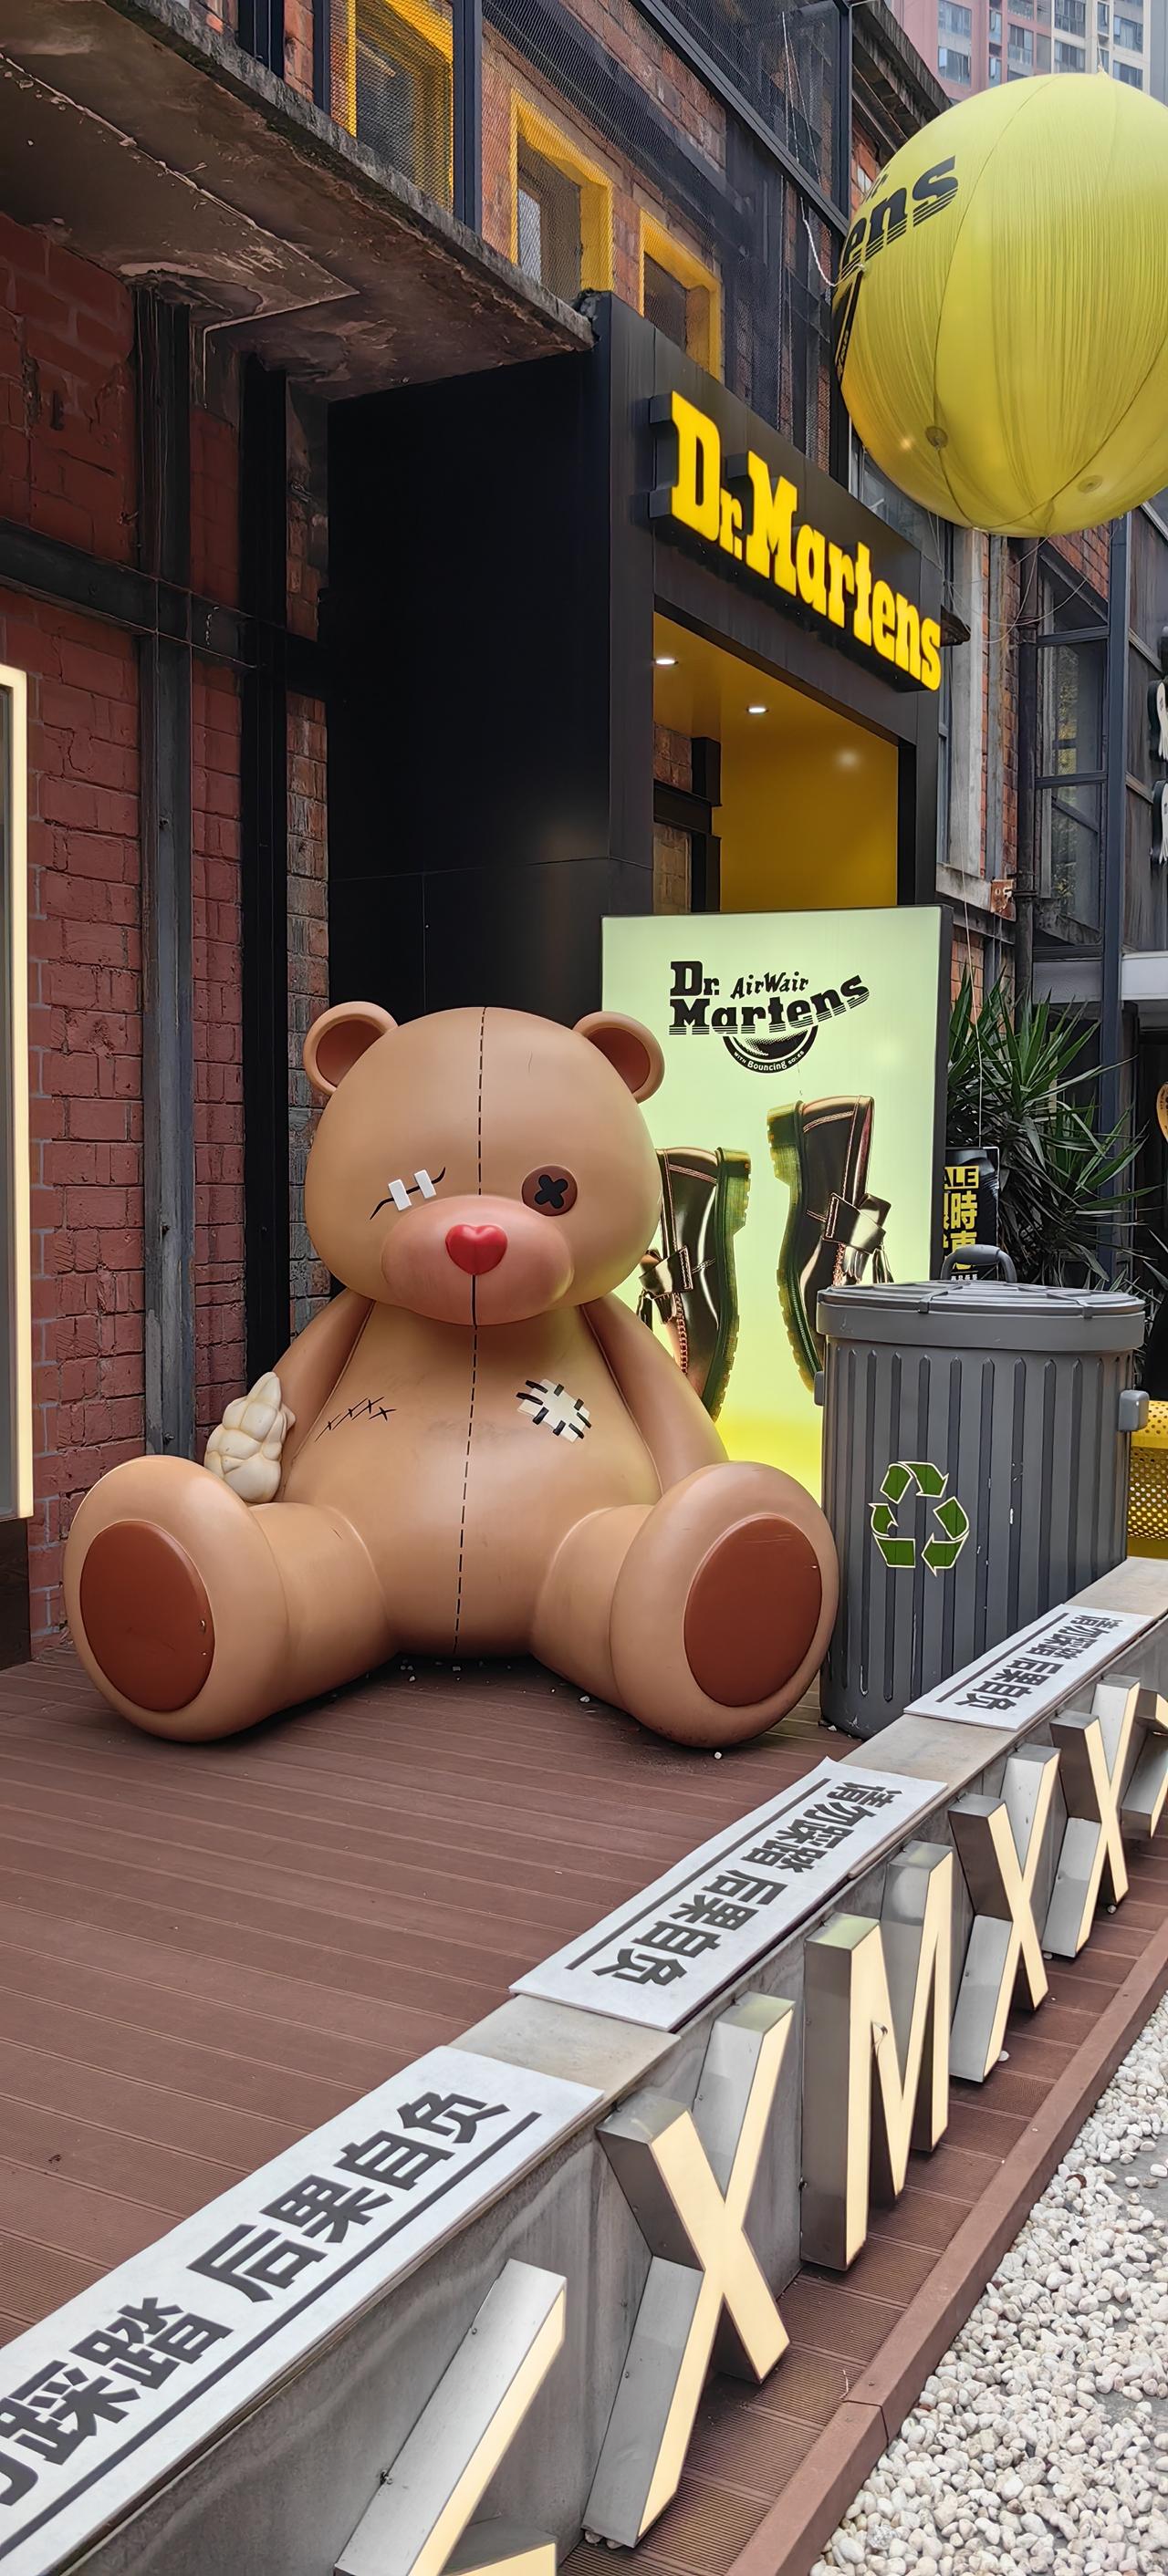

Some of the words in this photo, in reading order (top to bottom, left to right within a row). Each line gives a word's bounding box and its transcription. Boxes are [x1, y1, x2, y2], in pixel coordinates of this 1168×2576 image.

[669, 974, 870, 1035] Martens
[670, 961, 720, 996] Dr.
[730, 971, 809, 1000] AirWair
[747, 1060, 787, 1071] Bouncing
[1025, 1615, 1124, 1660] 请勿踩踏
[954, 1657, 1064, 1710] 后果自负
[740, 1781, 902, 1873] 请勿踩踏
[591, 1869, 788, 1986] 后果自负
[0, 2297, 234, 2506] 踩踏
[185, 2092, 510, 2302] 后果自负
